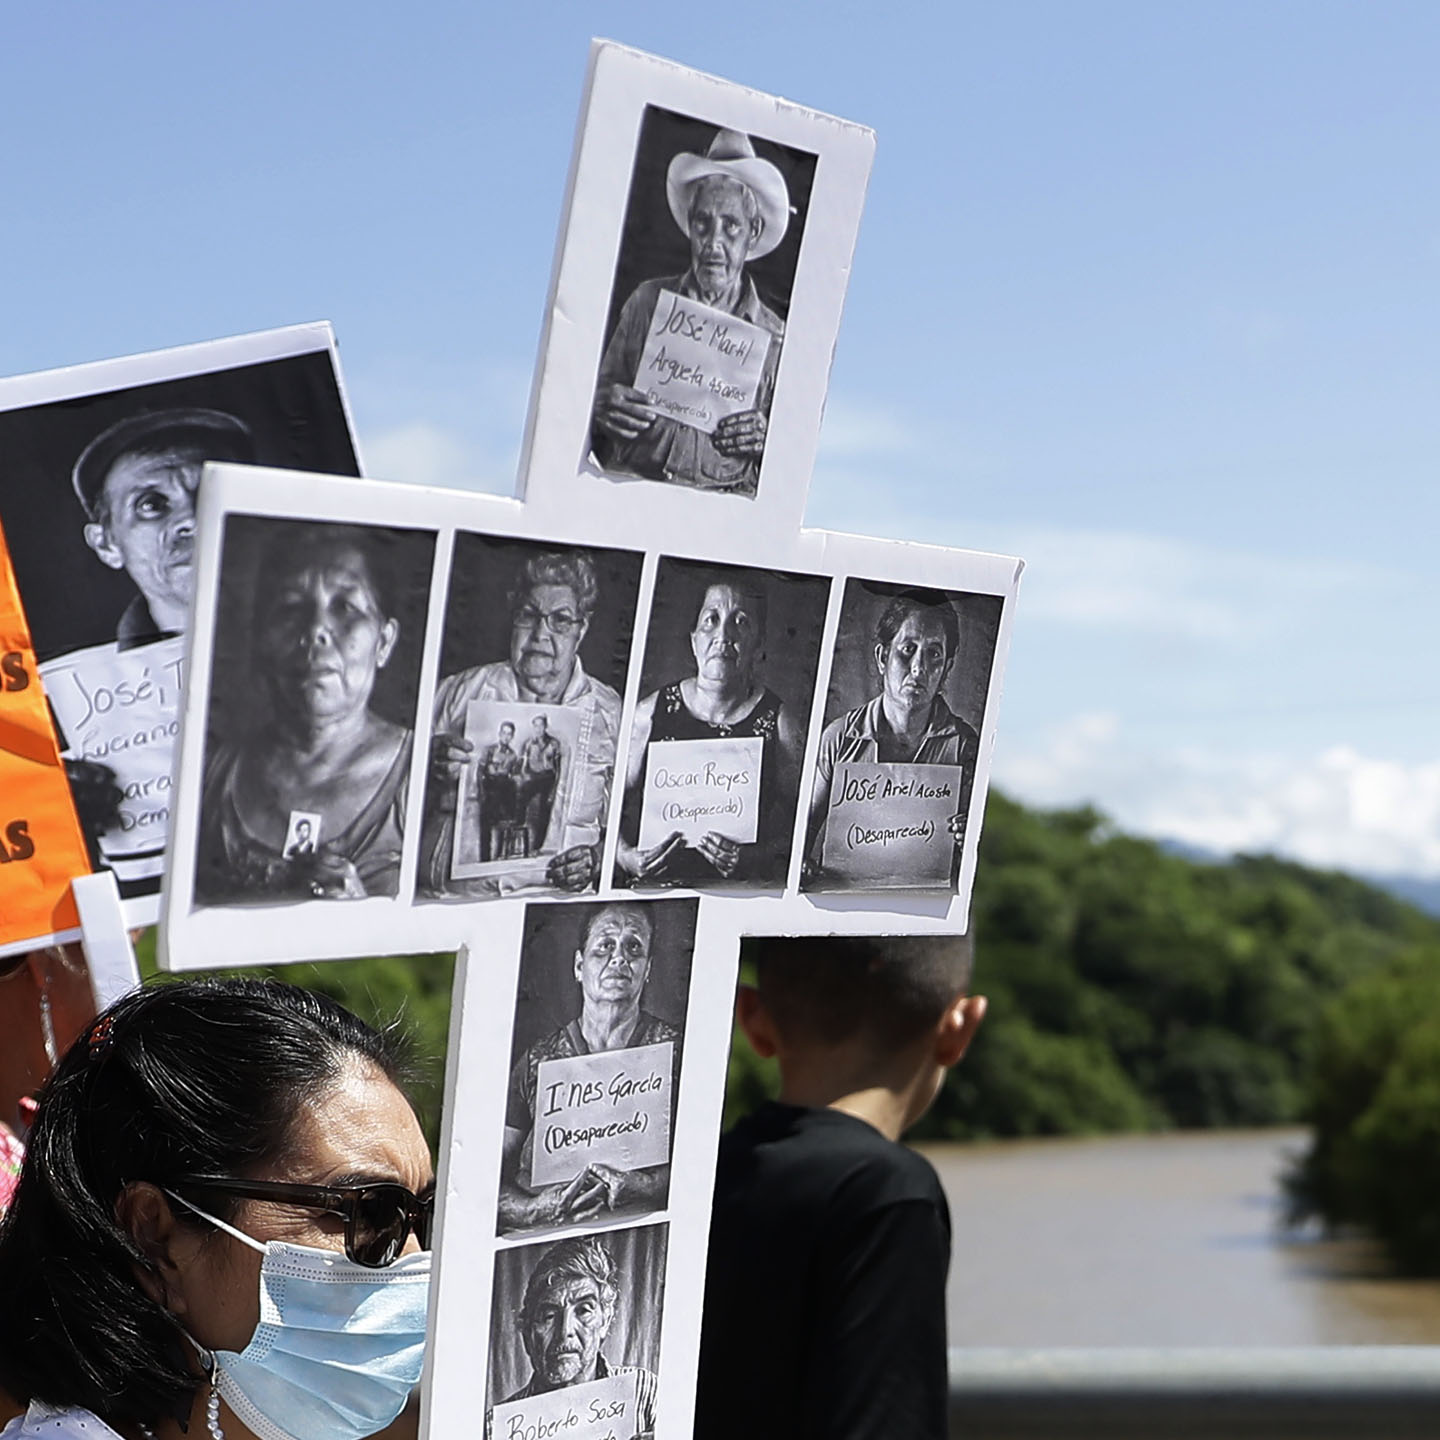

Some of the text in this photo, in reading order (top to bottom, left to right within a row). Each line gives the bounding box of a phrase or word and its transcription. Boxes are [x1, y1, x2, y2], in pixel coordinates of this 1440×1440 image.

[656, 296, 707, 341] José
[648, 345, 704, 388] Argueta
[654, 761, 750, 793] Oscar Reyes
[882, 778, 916, 799] Ariel
[915, 783, 952, 799] Acosta
[587, 1398, 626, 1424] Sosa
